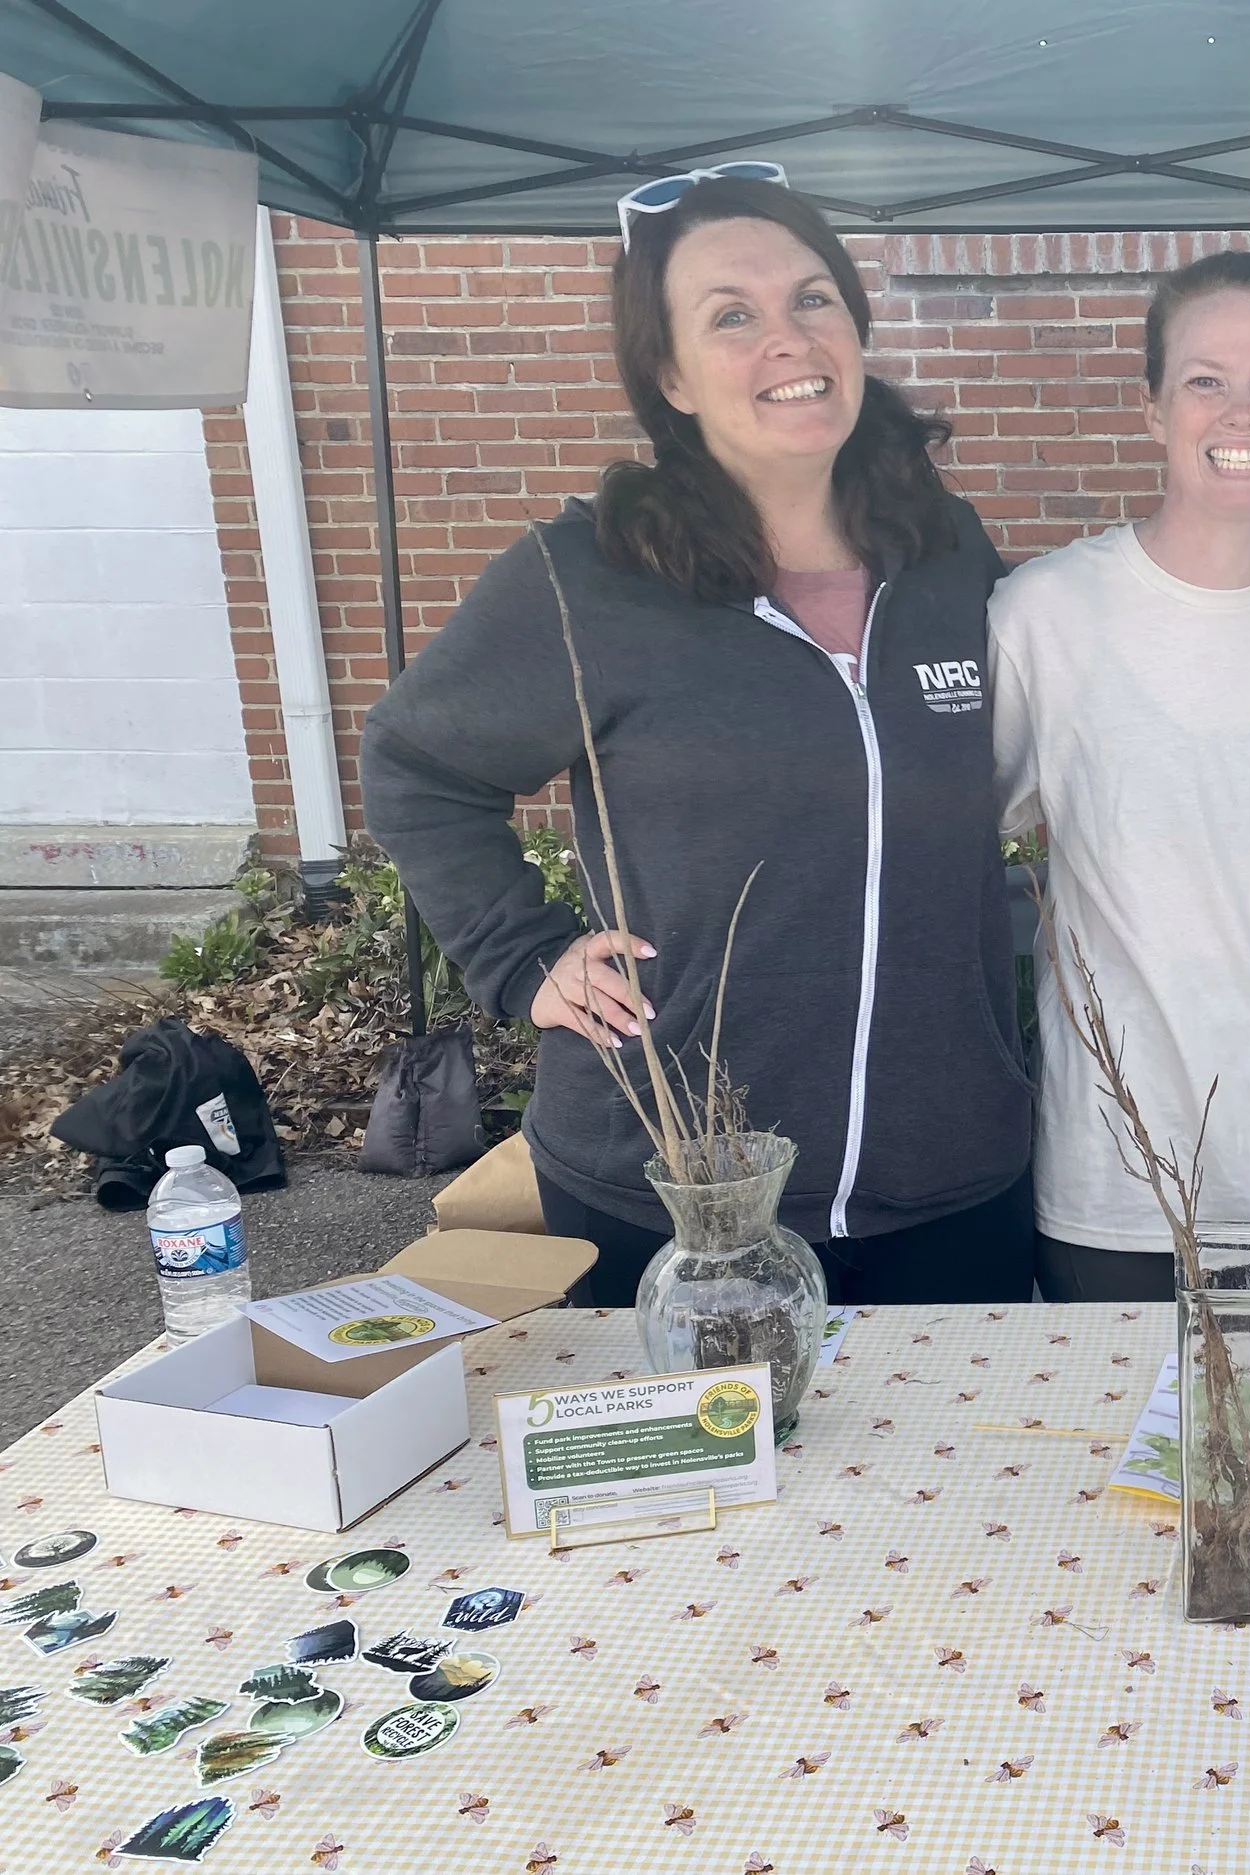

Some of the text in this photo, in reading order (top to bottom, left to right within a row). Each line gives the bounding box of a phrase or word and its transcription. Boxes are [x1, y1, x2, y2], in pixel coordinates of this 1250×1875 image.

[913, 660, 980, 690] NRC
[158, 1237, 202, 1248] ROXANE
[705, 1384, 751, 1400] FRIENDS OF
[527, 1381, 694, 1428] 5 WAYS WE SUPPORT
[556, 1398, 653, 1418] LOCAL PARKS
[554, 1436, 571, 1444] park
[572, 1431, 624, 1441] improvements
[640, 1422, 692, 1433] enhancements
[702, 1412, 756, 1436] NOLENSVILLE PARKS
[535, 1434, 663, 1455] Support community clean-up efforts
[536, 1451, 605, 1464] Mobilize volunteers
[538, 1474, 565, 1482] Provide
[572, 1466, 624, 1478] tax-deductible
[625, 1464, 640, 1472] way
[650, 1460, 671, 1468] invest
[681, 1454, 723, 1464] Nolensville's
[725, 1451, 744, 1459] parks
[626, 1454, 657, 1464] preserve
[658, 1451, 678, 1459] green
[451, 1606, 511, 1623] Wild
[390, 1717, 431, 1741] FOREST
[410, 1711, 442, 1730] SAVE
[380, 1727, 414, 1748] RECYCLE
